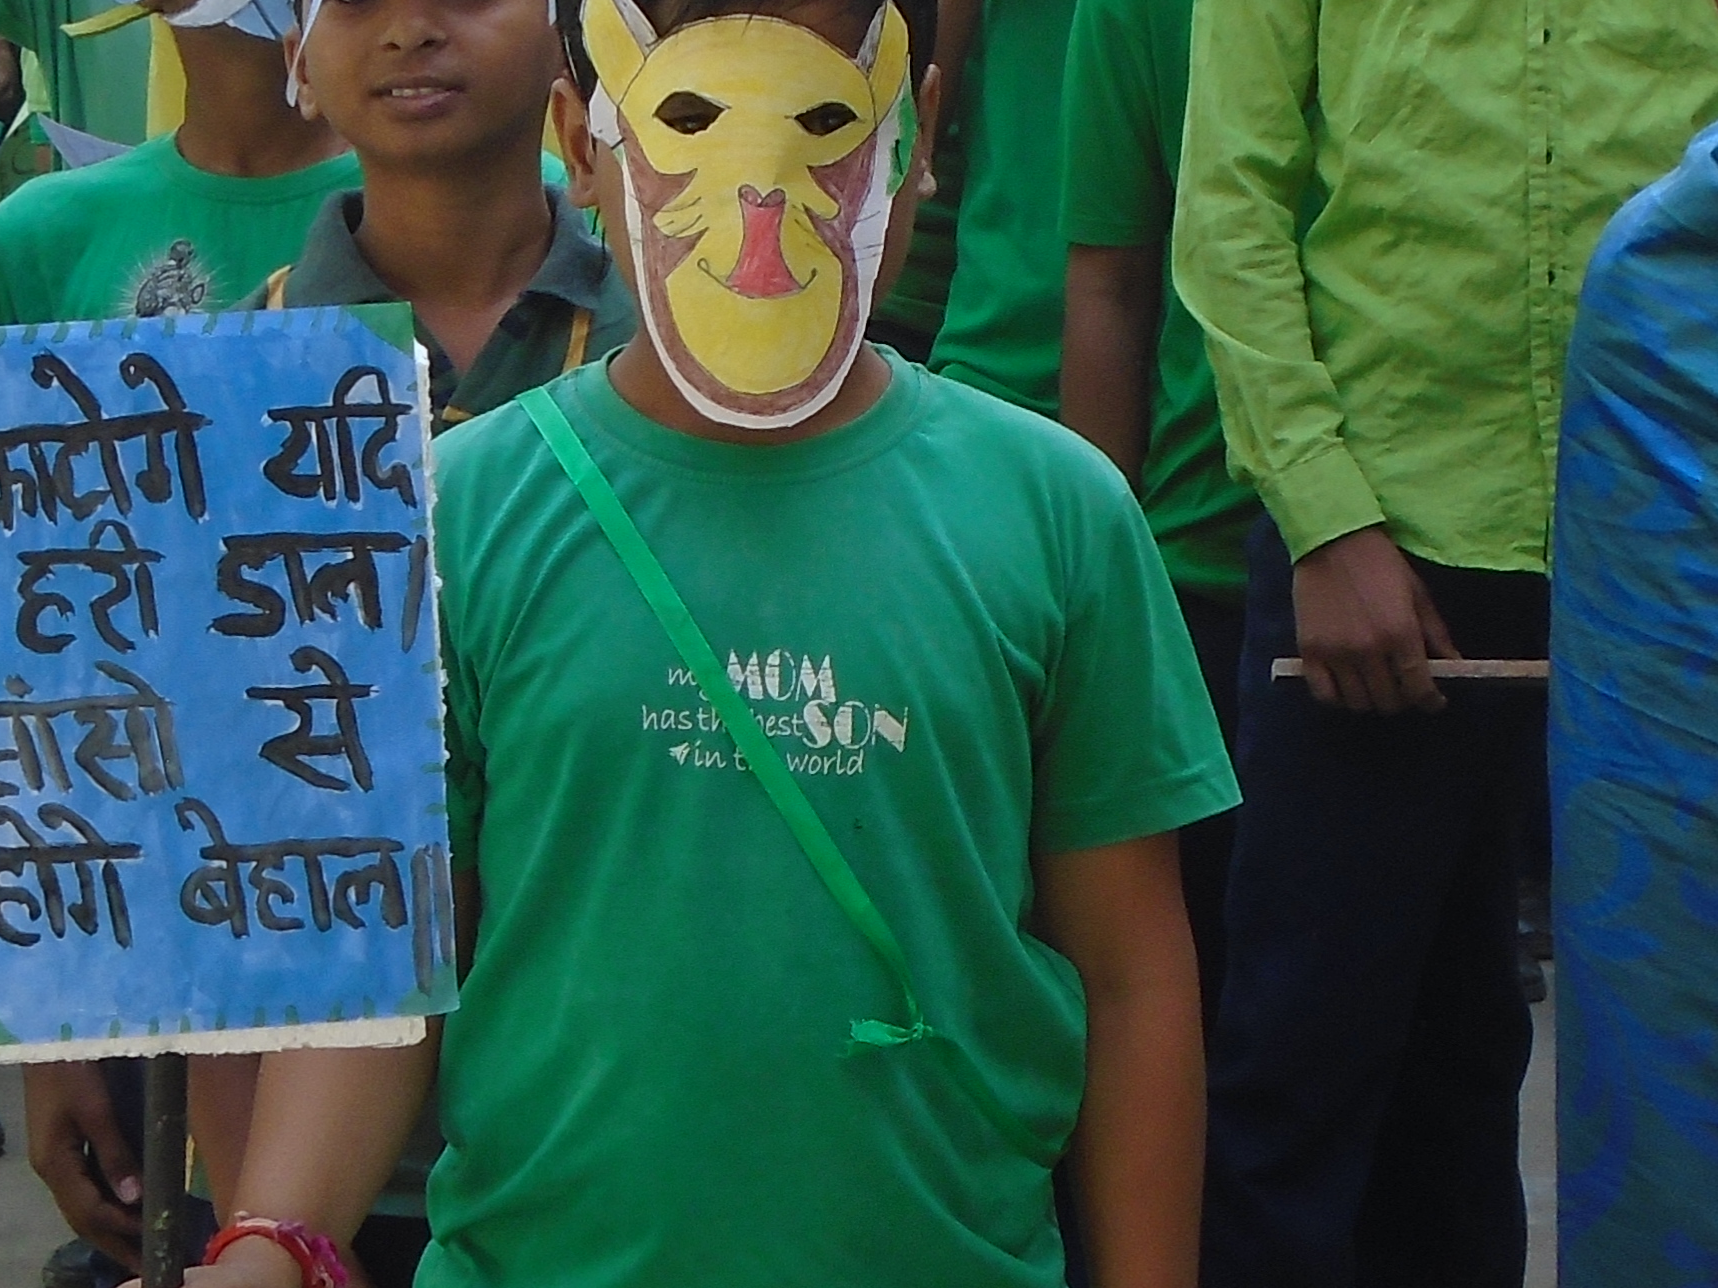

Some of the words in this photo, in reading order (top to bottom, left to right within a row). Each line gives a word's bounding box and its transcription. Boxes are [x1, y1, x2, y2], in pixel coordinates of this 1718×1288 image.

[261, 365, 418, 509] यदि
[16, 520, 166, 654] हरी
[245, 646, 380, 792] से
[668, 667, 709, 701] m
[726, 648, 837, 703] MOM
[642, 704, 693, 731] has
[696, 706, 725, 732] th
[802, 698, 910, 754] SON
[694, 739, 727, 768] in
[786, 748, 865, 776] world
